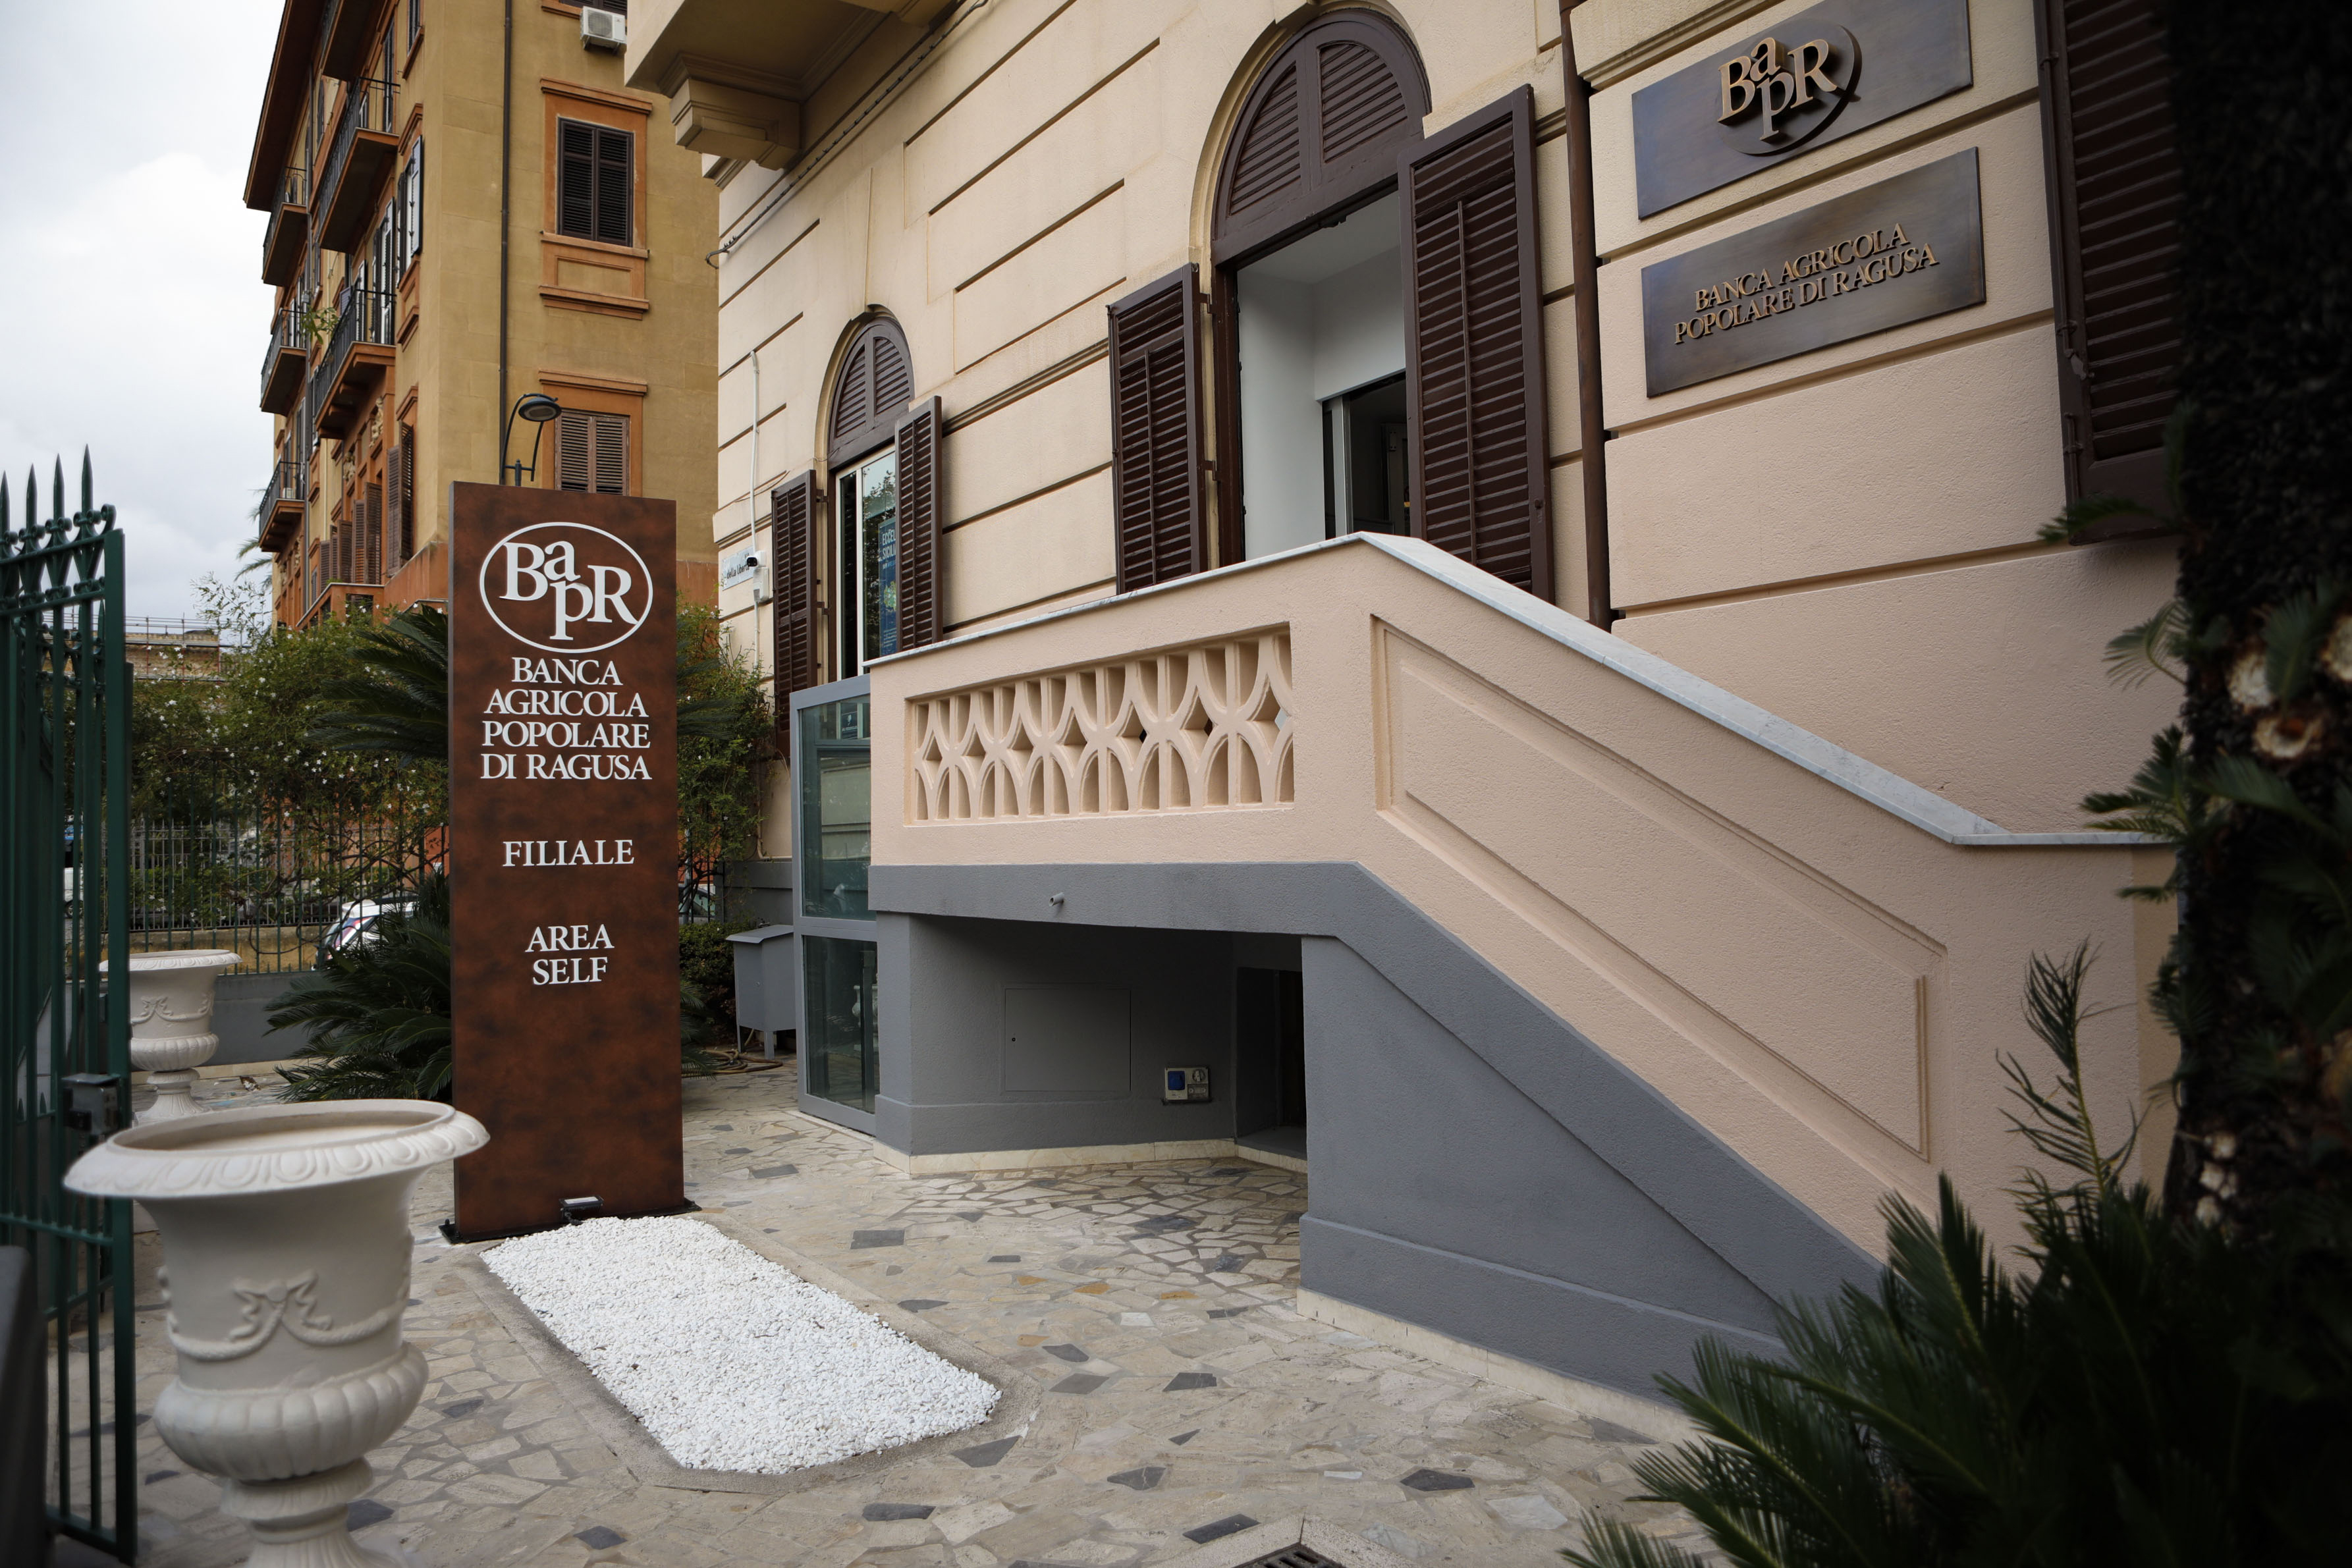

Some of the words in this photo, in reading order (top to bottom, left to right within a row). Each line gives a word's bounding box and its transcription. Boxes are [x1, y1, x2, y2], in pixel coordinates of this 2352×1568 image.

[1694, 268, 1776, 312] BANCA
[1778, 223, 1911, 286] AGRICOLA
[1674, 287, 1795, 344] POPOLARE
[1797, 276, 1827, 307] DI
[1831, 242, 1940, 296] RAGUSA
[511, 657, 624, 686] BANCA
[483, 688, 649, 717] AGRICOLA
[481, 720, 651, 748] POPOLARE
[480, 753, 517, 779] DI
[526, 753, 653, 780] RAGUSA
[503, 839, 634, 867] FILIALE
[525, 923, 615, 952] AREA
[532, 957, 608, 985] SELF
